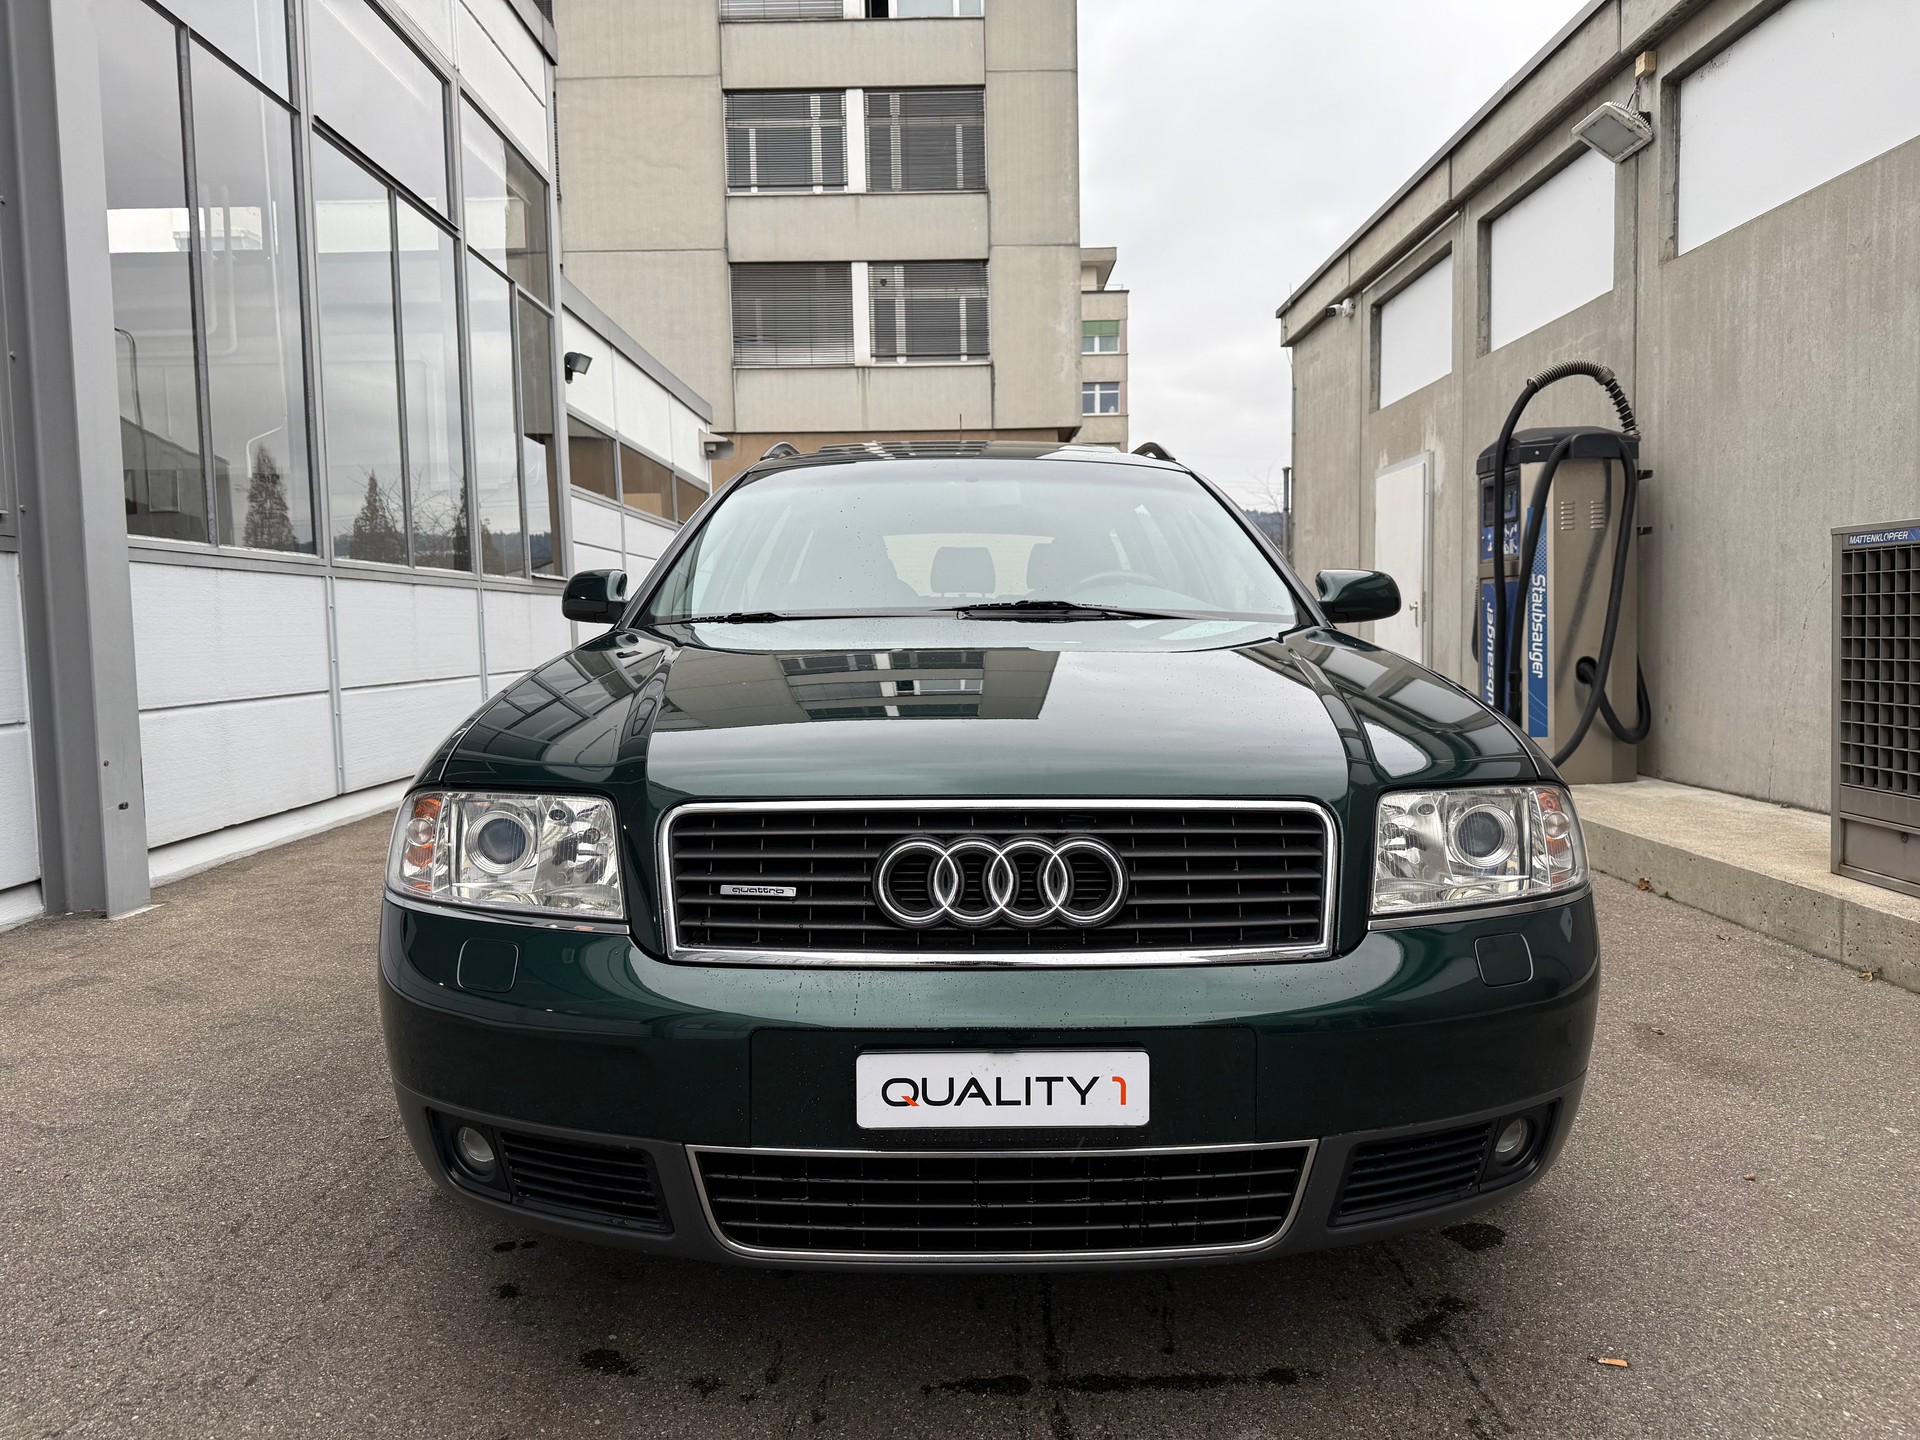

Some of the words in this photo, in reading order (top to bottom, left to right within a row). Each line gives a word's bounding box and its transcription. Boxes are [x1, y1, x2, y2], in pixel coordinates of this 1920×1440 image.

[1849, 531, 1909, 544] MATTENKLOPFER
[1529, 573, 1546, 679] Staubsauger
[1486, 602, 1496, 705] ubsauger
[732, 887, 785, 895] quattro
[881, 1076, 1100, 1107] QUALITY
[1112, 1076, 1127, 1106] 1
